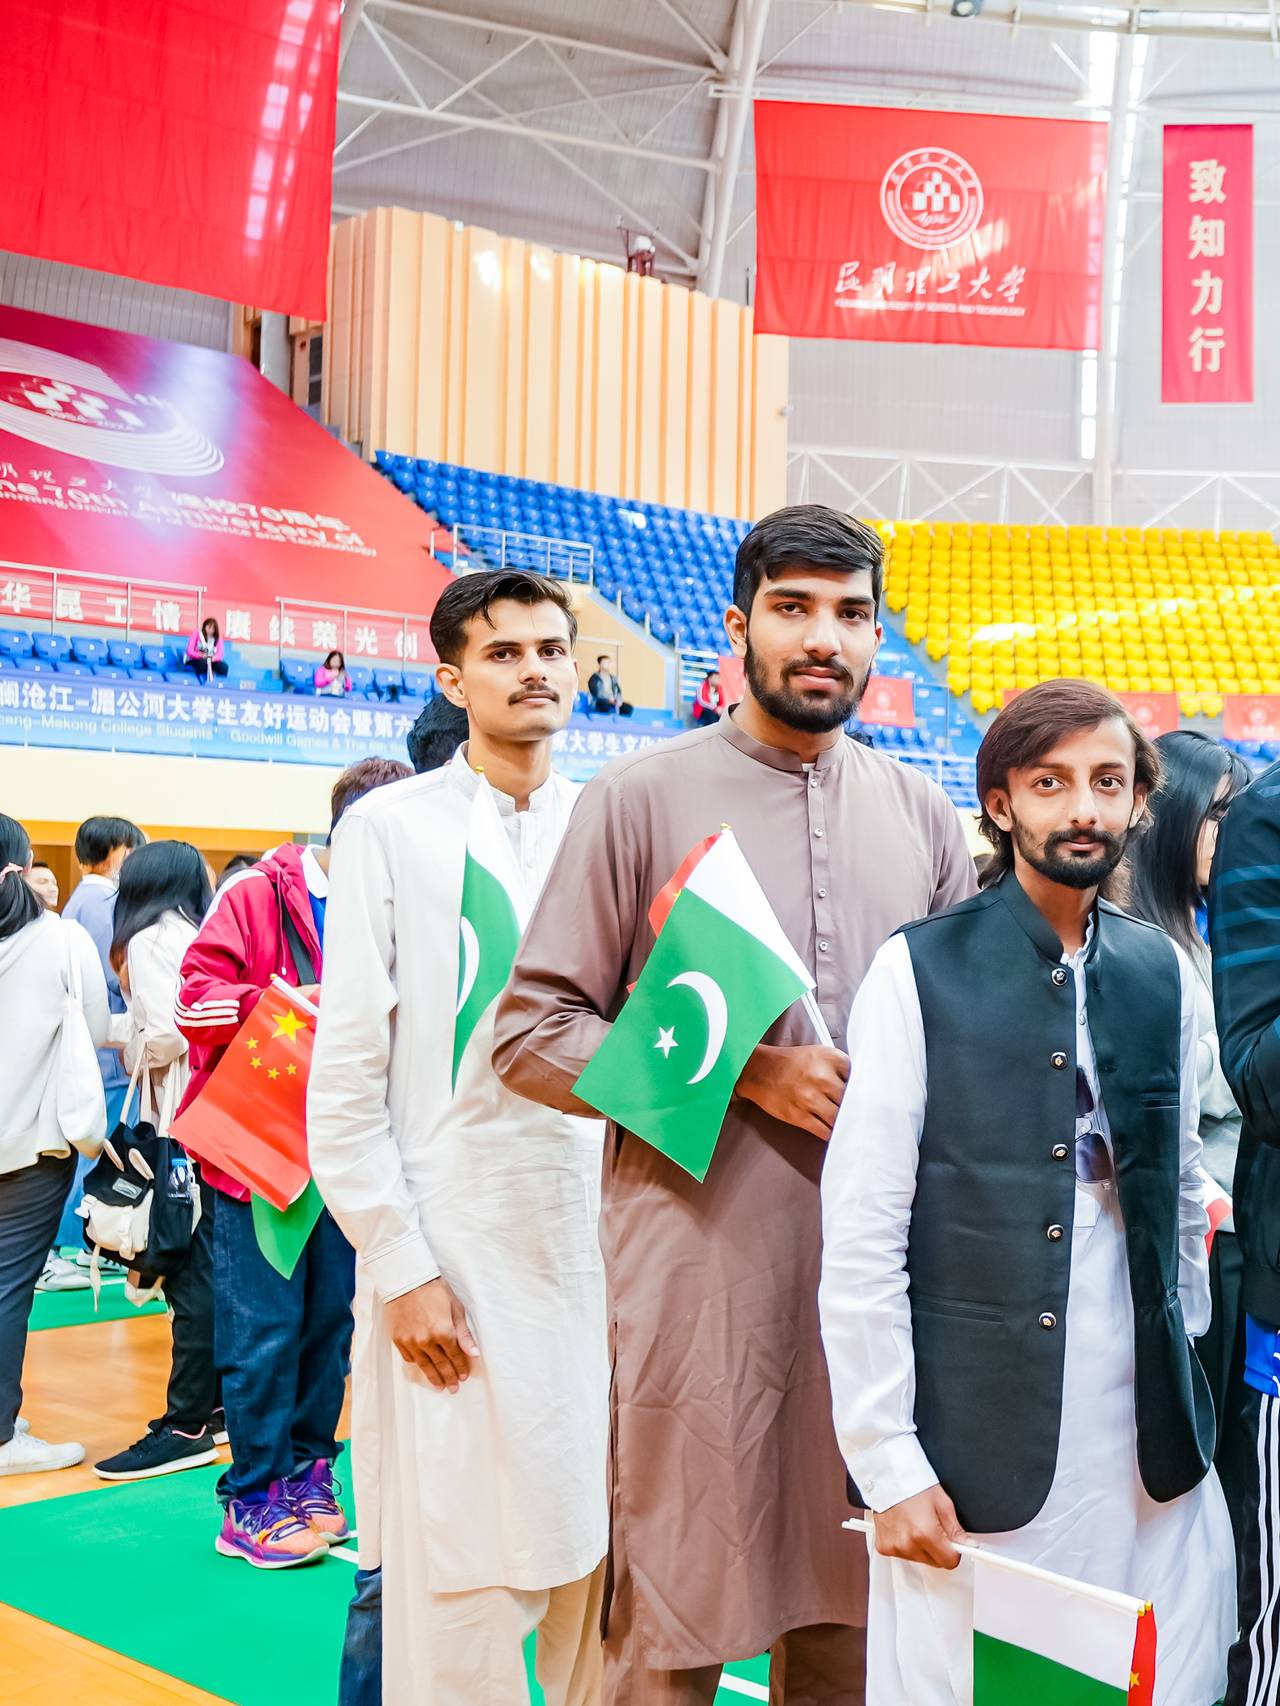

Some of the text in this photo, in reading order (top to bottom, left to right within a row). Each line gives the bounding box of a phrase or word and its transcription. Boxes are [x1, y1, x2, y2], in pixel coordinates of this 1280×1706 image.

[1188, 158, 1227, 373] 致知力行
[43, 484, 128, 510] 70th
[139, 499, 326, 544] Anniversary
[334, 531, 366, 547] of
[101, 718, 152, 737] College
[230, 729, 283, 746] Goodwill
[287, 733, 330, 748] Games
